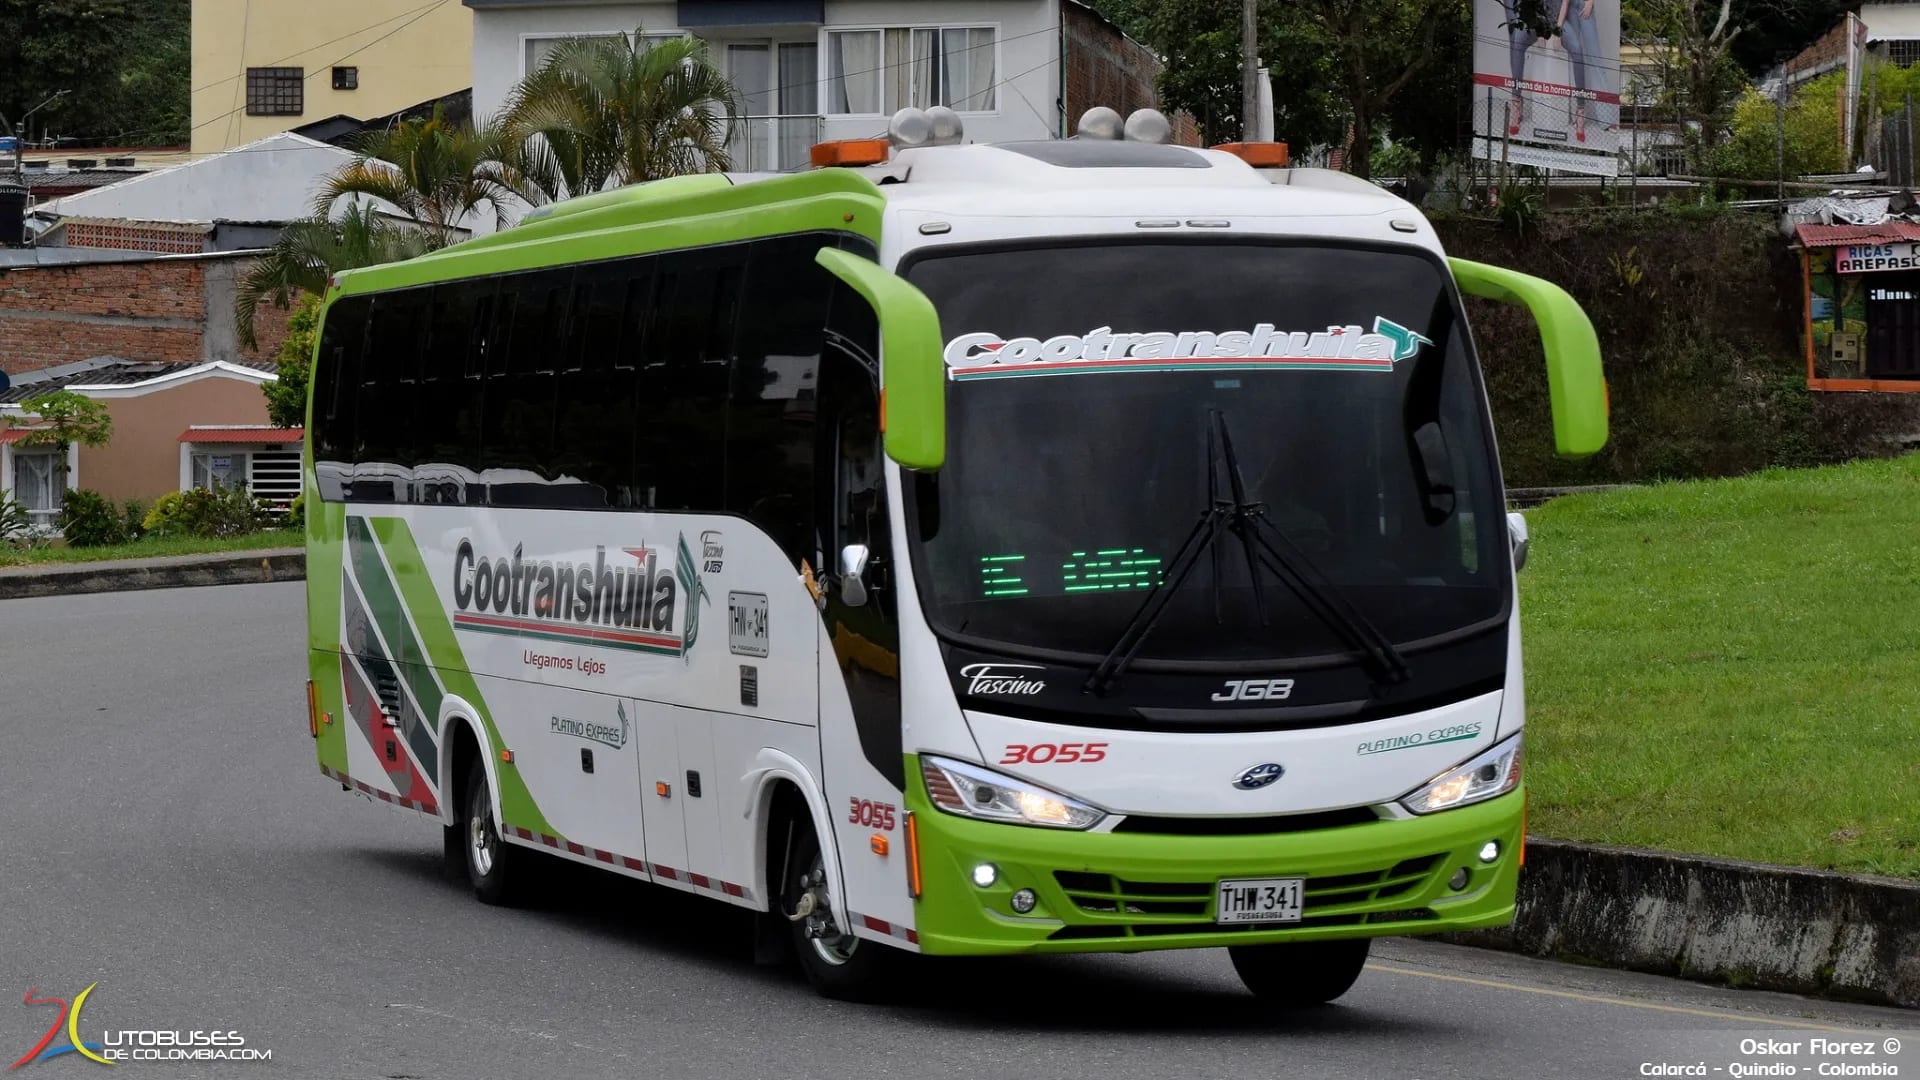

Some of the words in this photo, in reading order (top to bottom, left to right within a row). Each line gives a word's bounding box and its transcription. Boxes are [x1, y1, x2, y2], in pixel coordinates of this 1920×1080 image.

[1516, 80, 1533, 91] jeans
[1534, 83, 1543, 91] de
[1543, 84, 1550, 93] la
[1551, 85, 1570, 96] horma
[1571, 89, 1596, 100] perfecta
[1839, 257, 1911, 271] AREPAS
[1848, 245, 1893, 259] RICAS
[944, 323, 1395, 369] Cootranshuila
[453, 536, 678, 633] Cootranshuila
[523, 649, 573, 670] Llegamos
[577, 655, 606, 676] Lejos
[960, 663, 1047, 695] Fascino
[1211, 679, 1295, 701] JGB
[551, 716, 584, 736] PLATINO
[585, 723, 619, 742] EXPRES
[1357, 732, 1423, 754] PLATINO
[1427, 721, 1482, 740] EXPRES
[999, 743, 1109, 765] 3055
[848, 796, 895, 831] 3055
